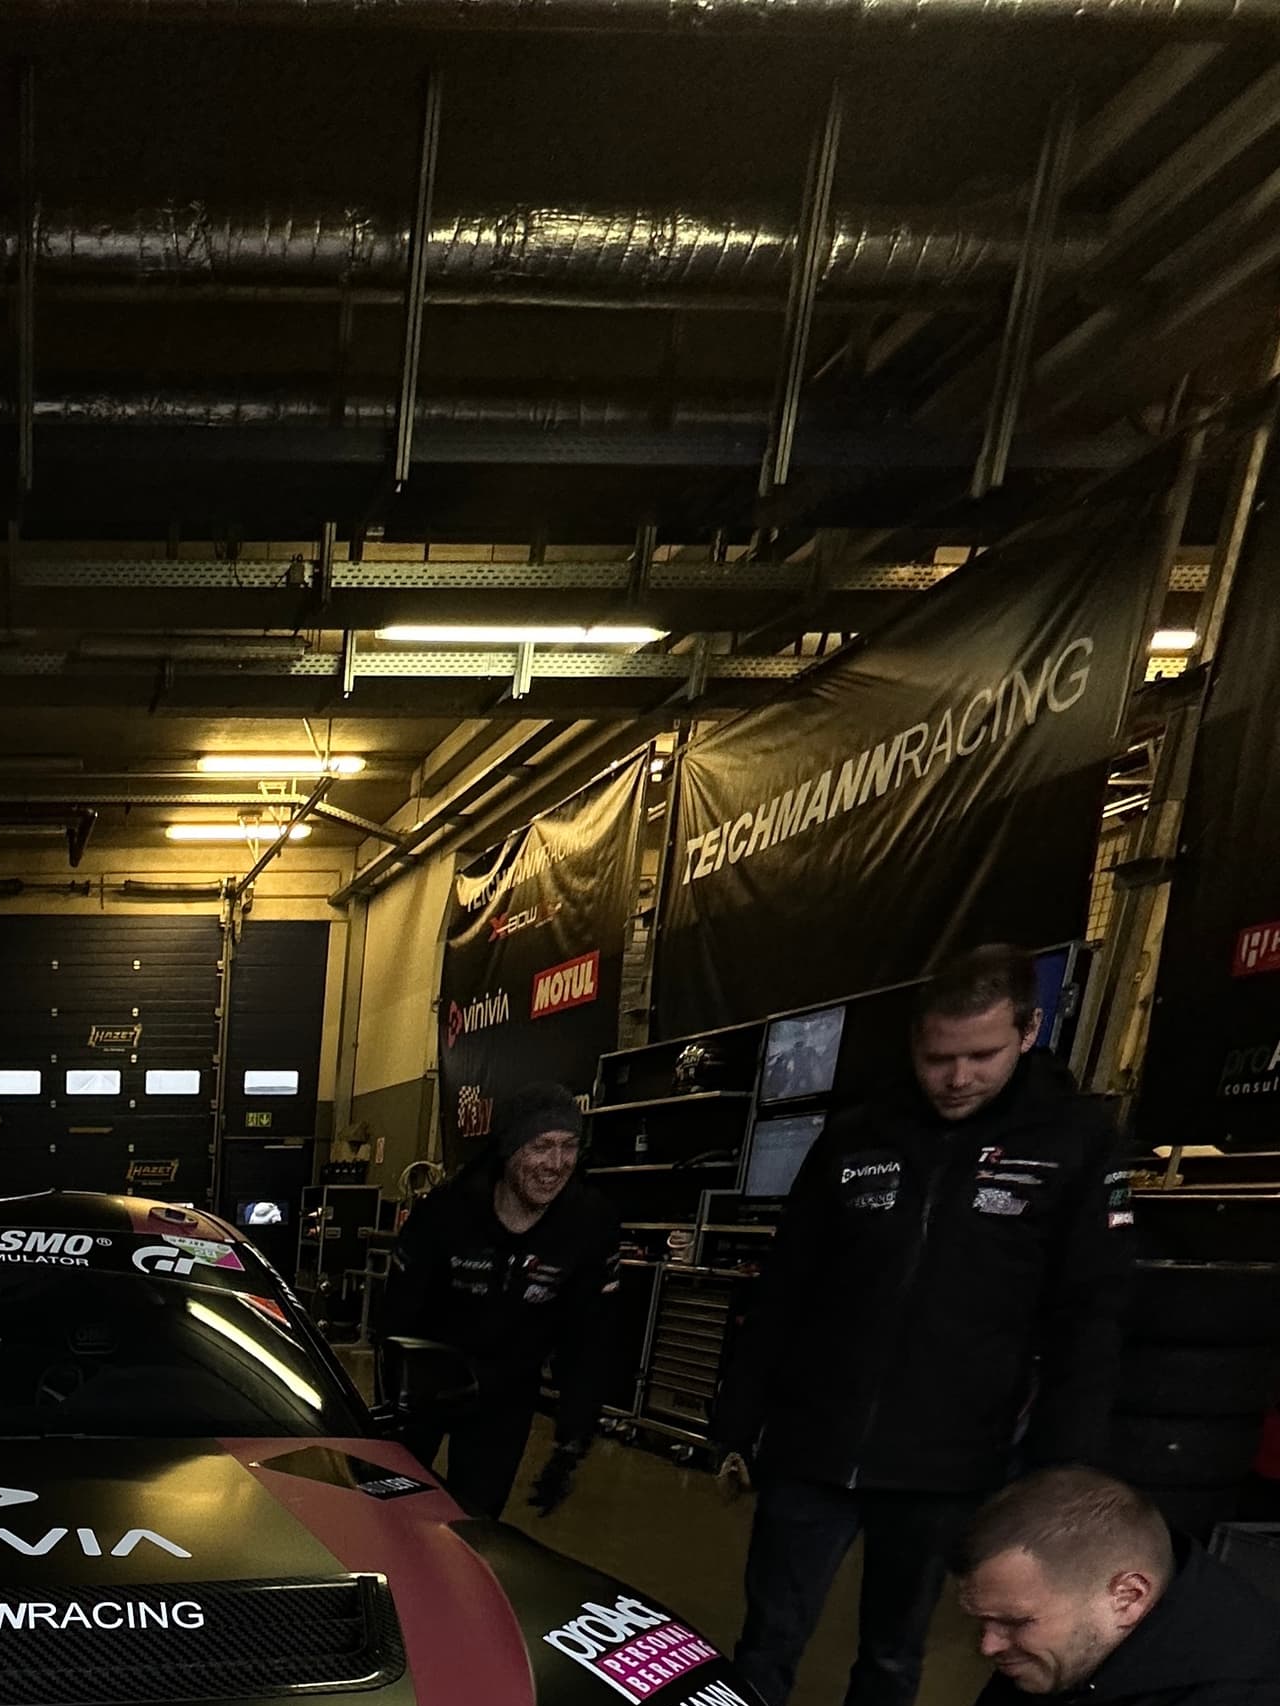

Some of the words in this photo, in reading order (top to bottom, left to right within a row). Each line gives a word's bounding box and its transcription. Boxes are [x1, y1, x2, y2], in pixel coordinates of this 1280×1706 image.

[682, 636, 1094, 886] TEICHMANNRACING
[535, 960, 595, 1012] MOTUL
[543, 1595, 671, 1685] proAct
[602, 1624, 696, 1675] PERSONAL
[625, 1639, 720, 1695] BERATUNG
